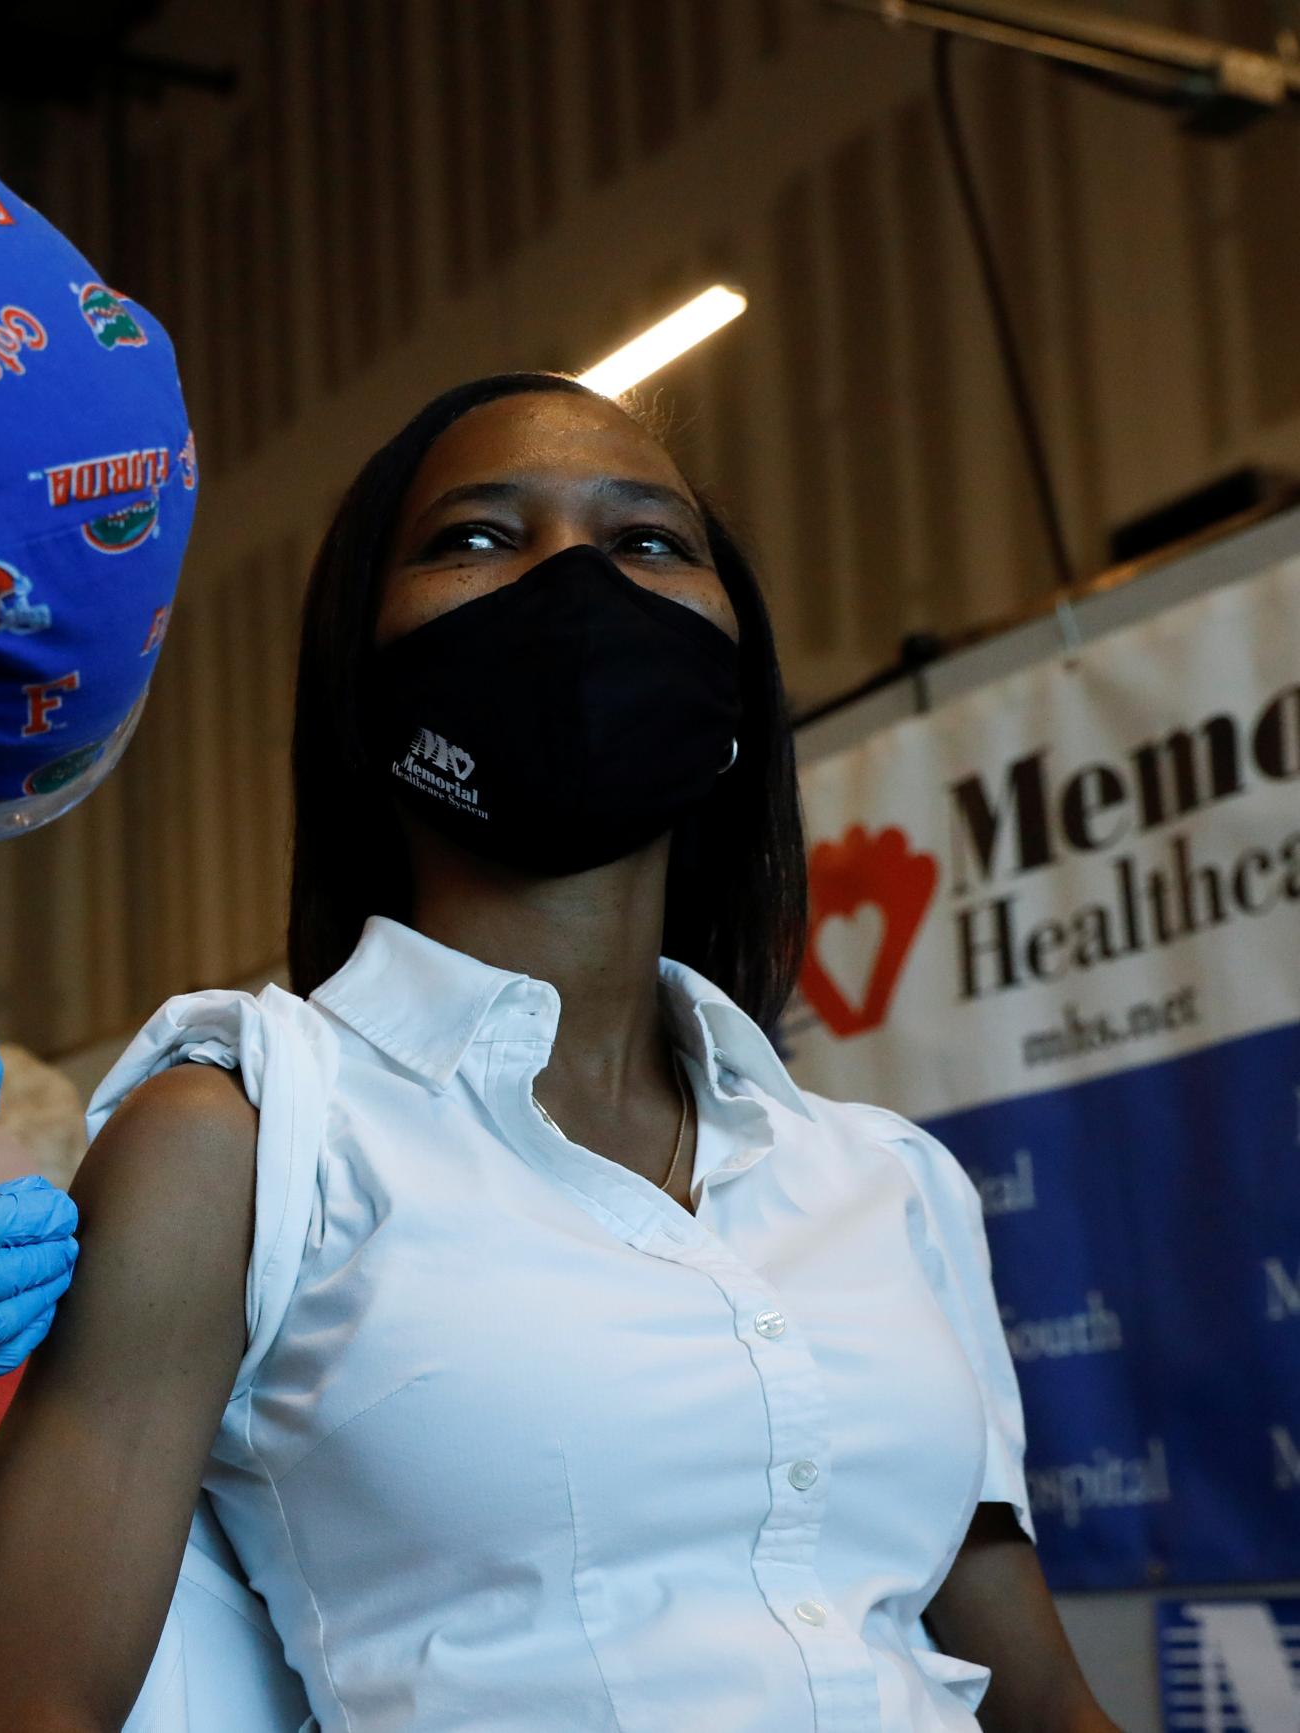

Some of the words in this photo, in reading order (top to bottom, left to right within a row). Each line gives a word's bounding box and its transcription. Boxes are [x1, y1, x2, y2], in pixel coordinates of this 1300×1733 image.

[44, 446, 169, 507] FLORIDA
[20, 669, 81, 738] F
[391, 760, 446, 801] Healthcare
[447, 794, 489, 821] System
[399, 751, 479, 806] Memorial
